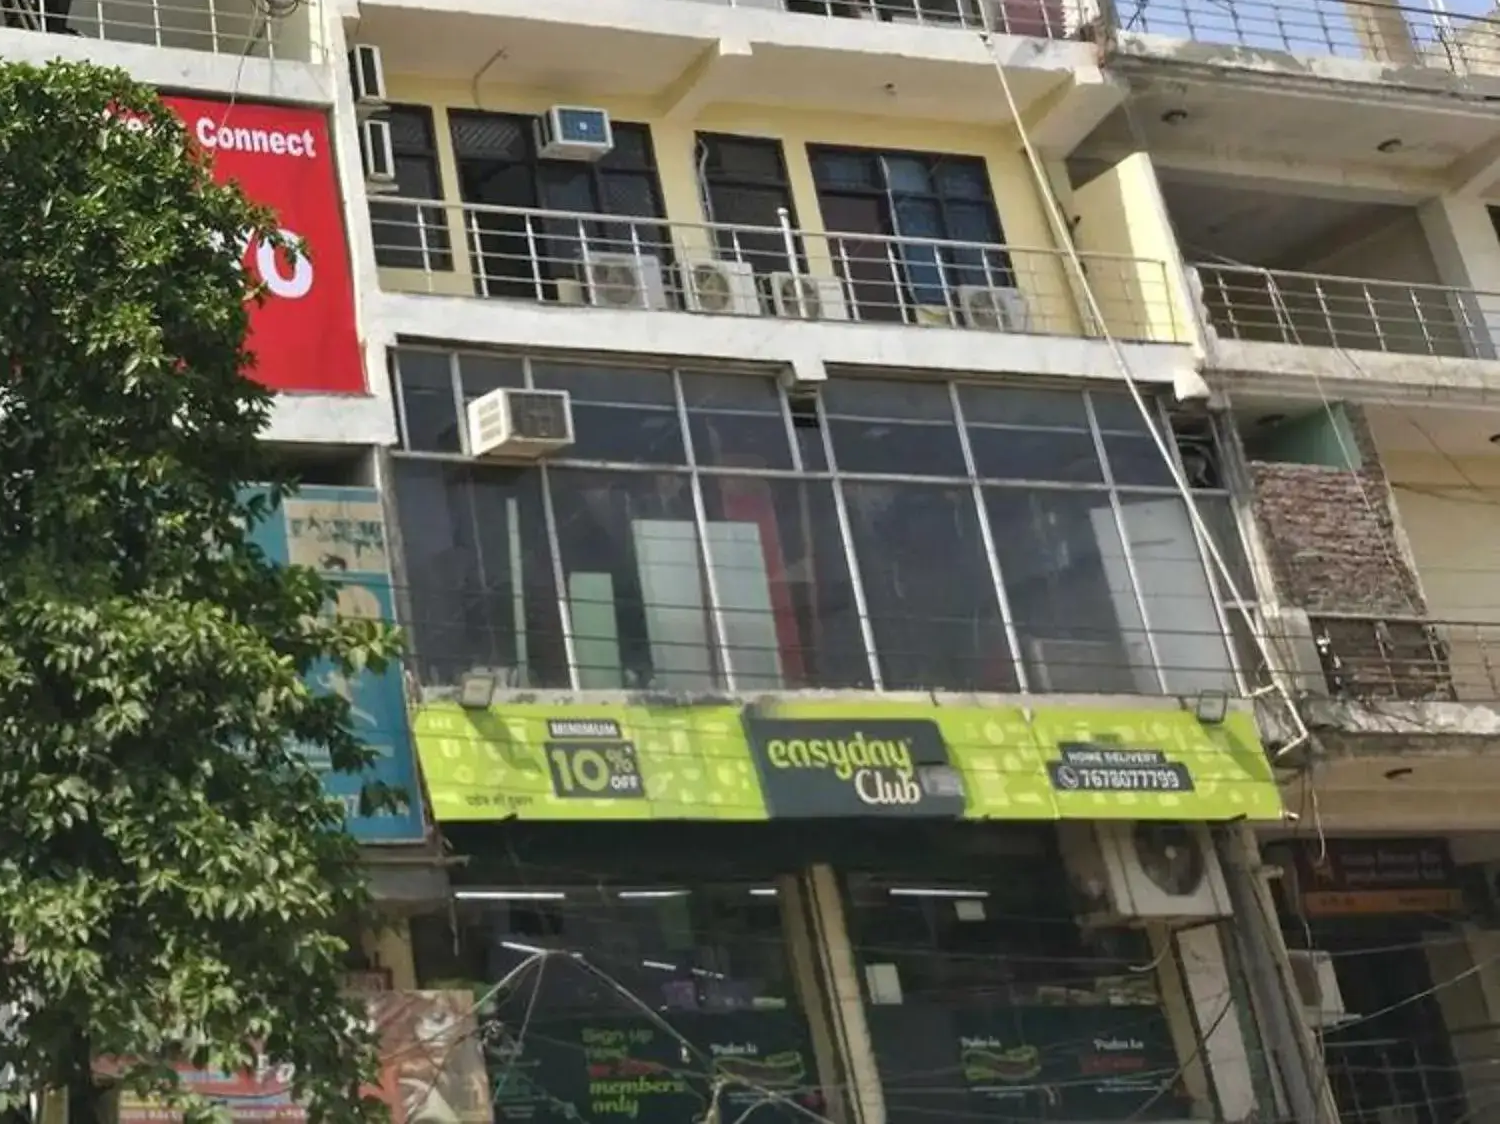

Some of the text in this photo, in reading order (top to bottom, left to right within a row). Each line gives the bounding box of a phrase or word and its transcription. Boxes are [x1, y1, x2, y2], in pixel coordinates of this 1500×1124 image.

[196, 117, 316, 158] Connect
[550, 722, 619, 737] MINIMUM
[767, 731, 913, 780] easyday
[1067, 751, 1158, 765] HOME DELIVERY
[611, 775, 639, 790] OFF
[854, 768, 922, 805] Club
[590, 1076, 685, 1095] members
[592, 1094, 639, 1117] only
